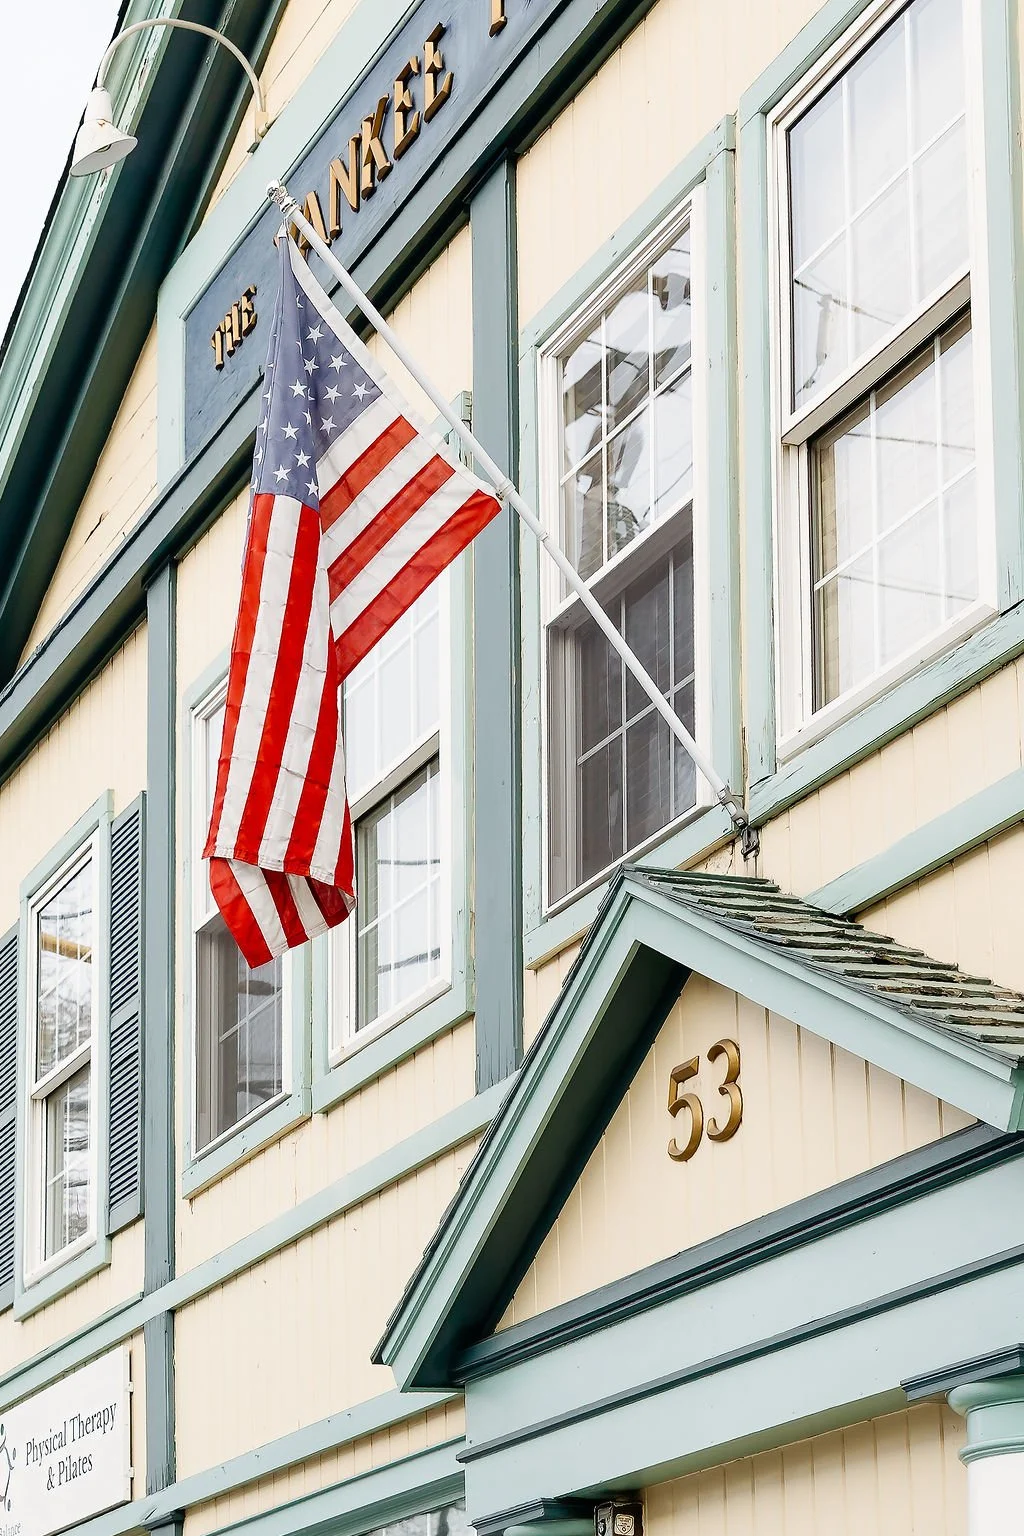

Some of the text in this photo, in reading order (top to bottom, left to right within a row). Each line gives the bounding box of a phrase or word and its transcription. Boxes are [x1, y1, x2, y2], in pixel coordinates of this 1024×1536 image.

[211, 22, 454, 371] THE ANKEE
[668, 1038, 743, 1162] 53
[26, 1402, 117, 1467] Physical Therapy
[46, 1453, 93, 1491] & Pilates
